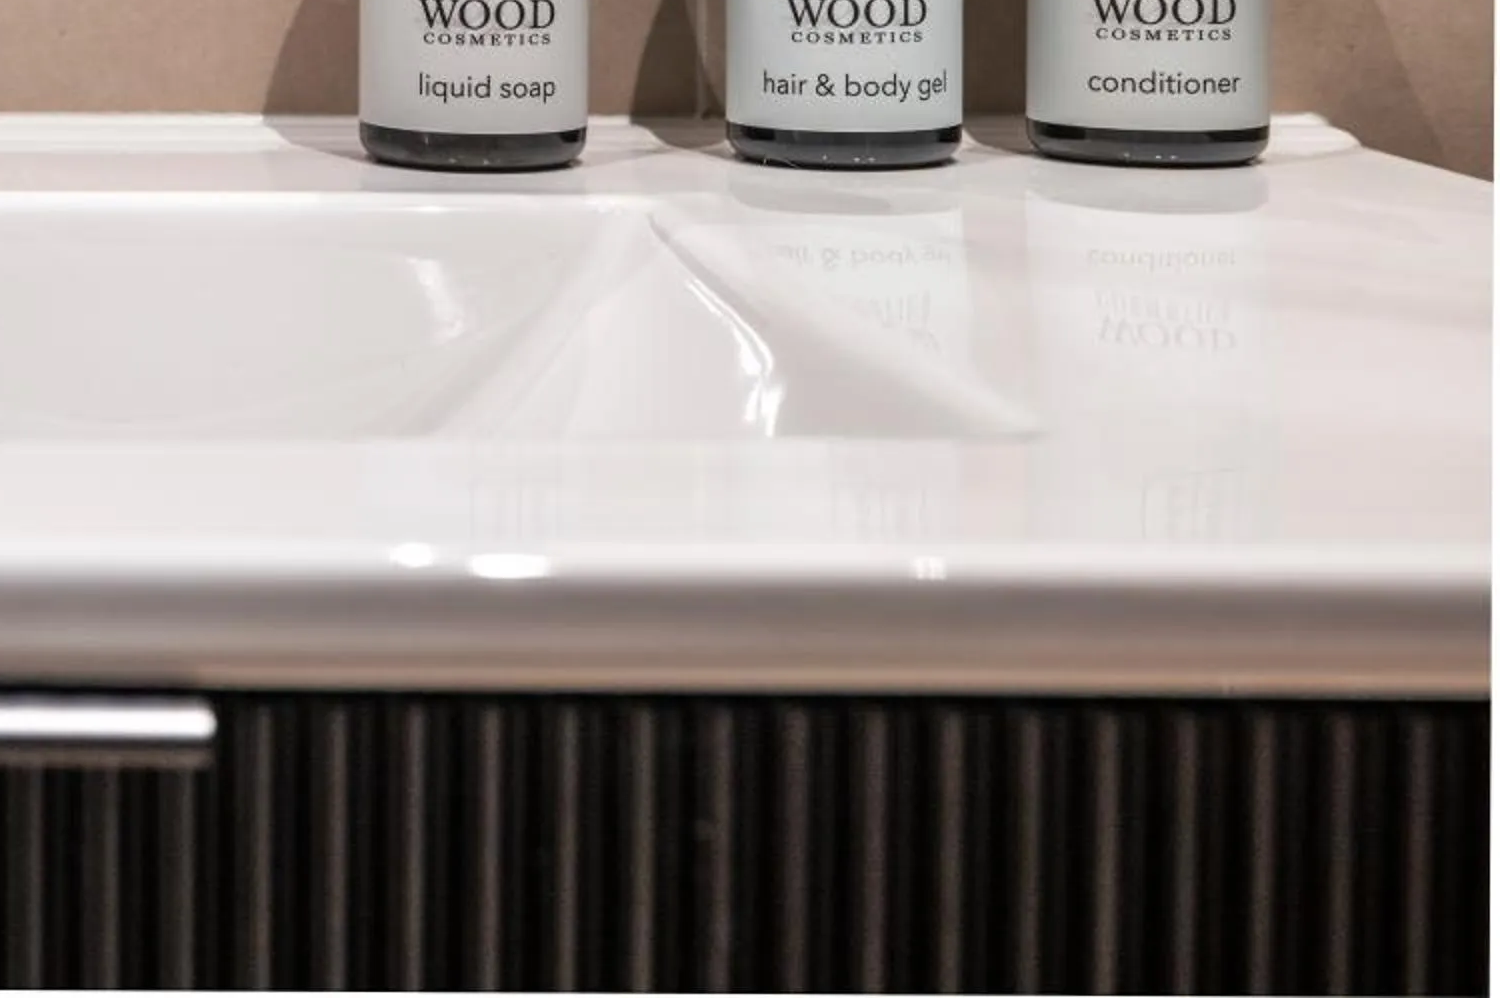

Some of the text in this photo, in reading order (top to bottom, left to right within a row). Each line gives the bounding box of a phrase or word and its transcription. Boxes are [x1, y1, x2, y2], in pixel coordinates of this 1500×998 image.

[423, 32, 551, 47] COSMETICS
[791, 31, 923, 45] COSMETICS
[1095, 27, 1232, 42] COSMETICS
[419, 72, 556, 105] liquid soap
[763, 69, 947, 103] hair & body gel
[1087, 70, 1241, 95] conditioner
